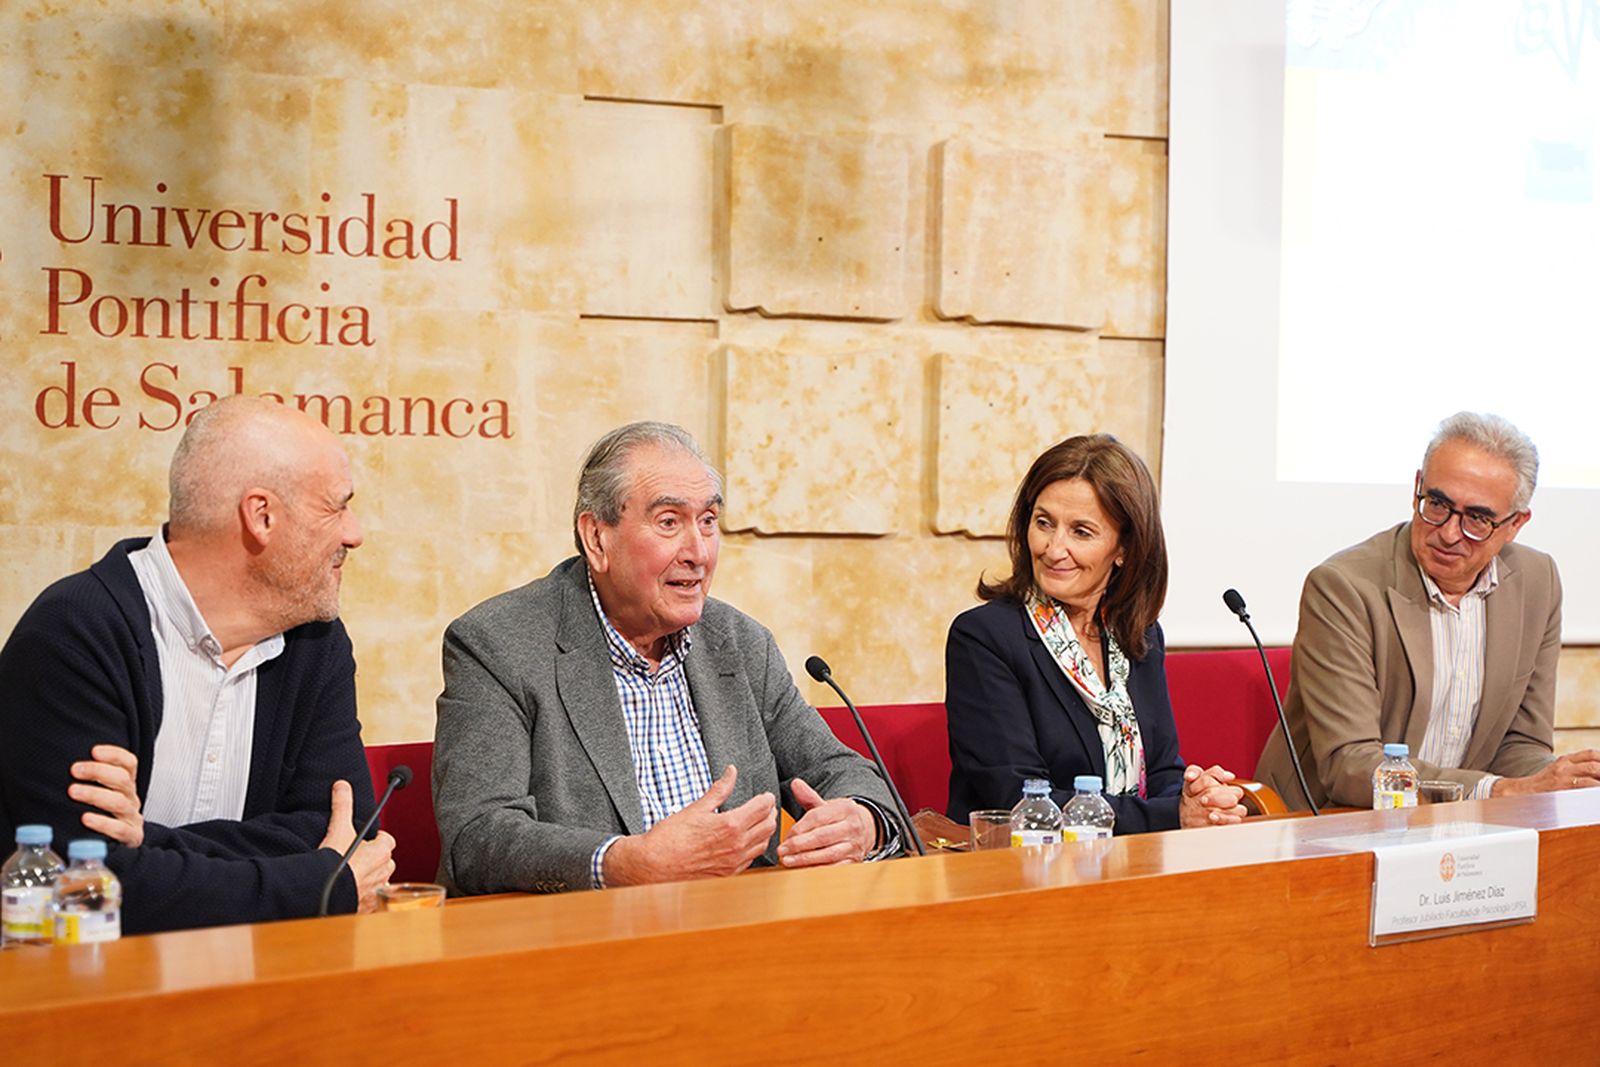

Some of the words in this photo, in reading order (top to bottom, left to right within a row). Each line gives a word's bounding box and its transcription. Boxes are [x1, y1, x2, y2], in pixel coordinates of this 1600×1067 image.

[42, 174, 462, 261] Universidad
[39, 267, 376, 347] Pontificia
[34, 361, 121, 430] de
[1419, 894, 1432, 907] Dr.
[1433, 891, 1451, 905] Luis
